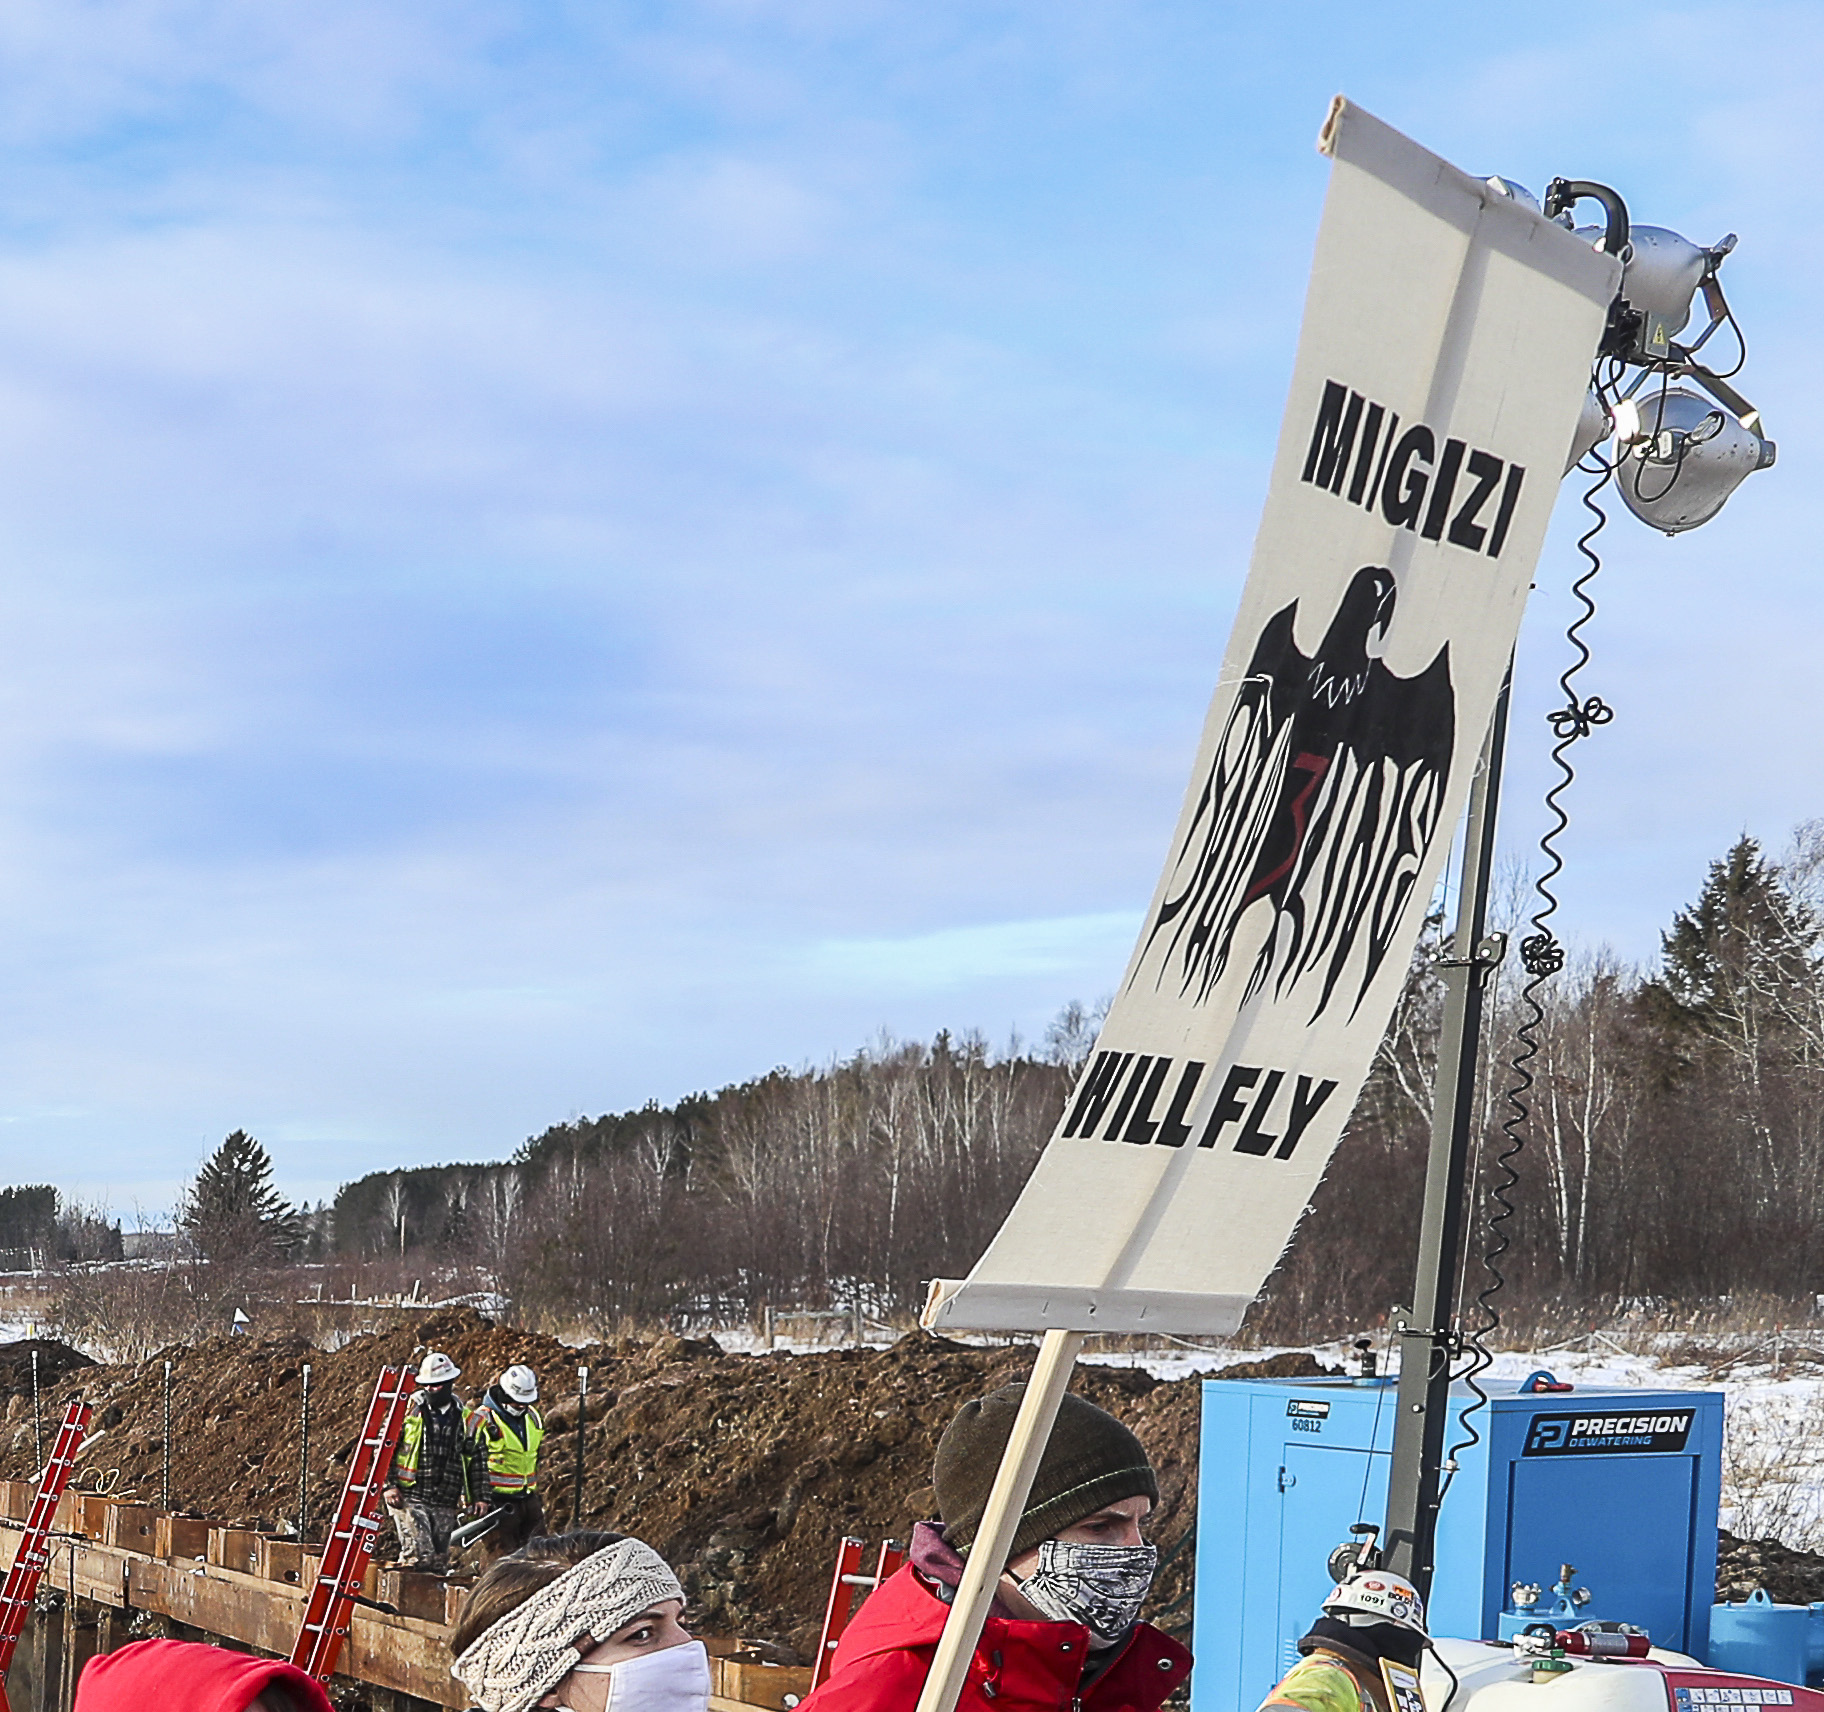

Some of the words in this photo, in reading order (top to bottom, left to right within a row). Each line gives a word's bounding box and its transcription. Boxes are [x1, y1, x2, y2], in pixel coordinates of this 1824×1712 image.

[1060, 1051, 1206, 1148] WILL
[1197, 1063, 1340, 1161] FLY
[1292, 1418, 1321, 1433] 60812
[1571, 1415, 1689, 1436] PRECISION
[1568, 1435, 1653, 1448] DEWATERING
